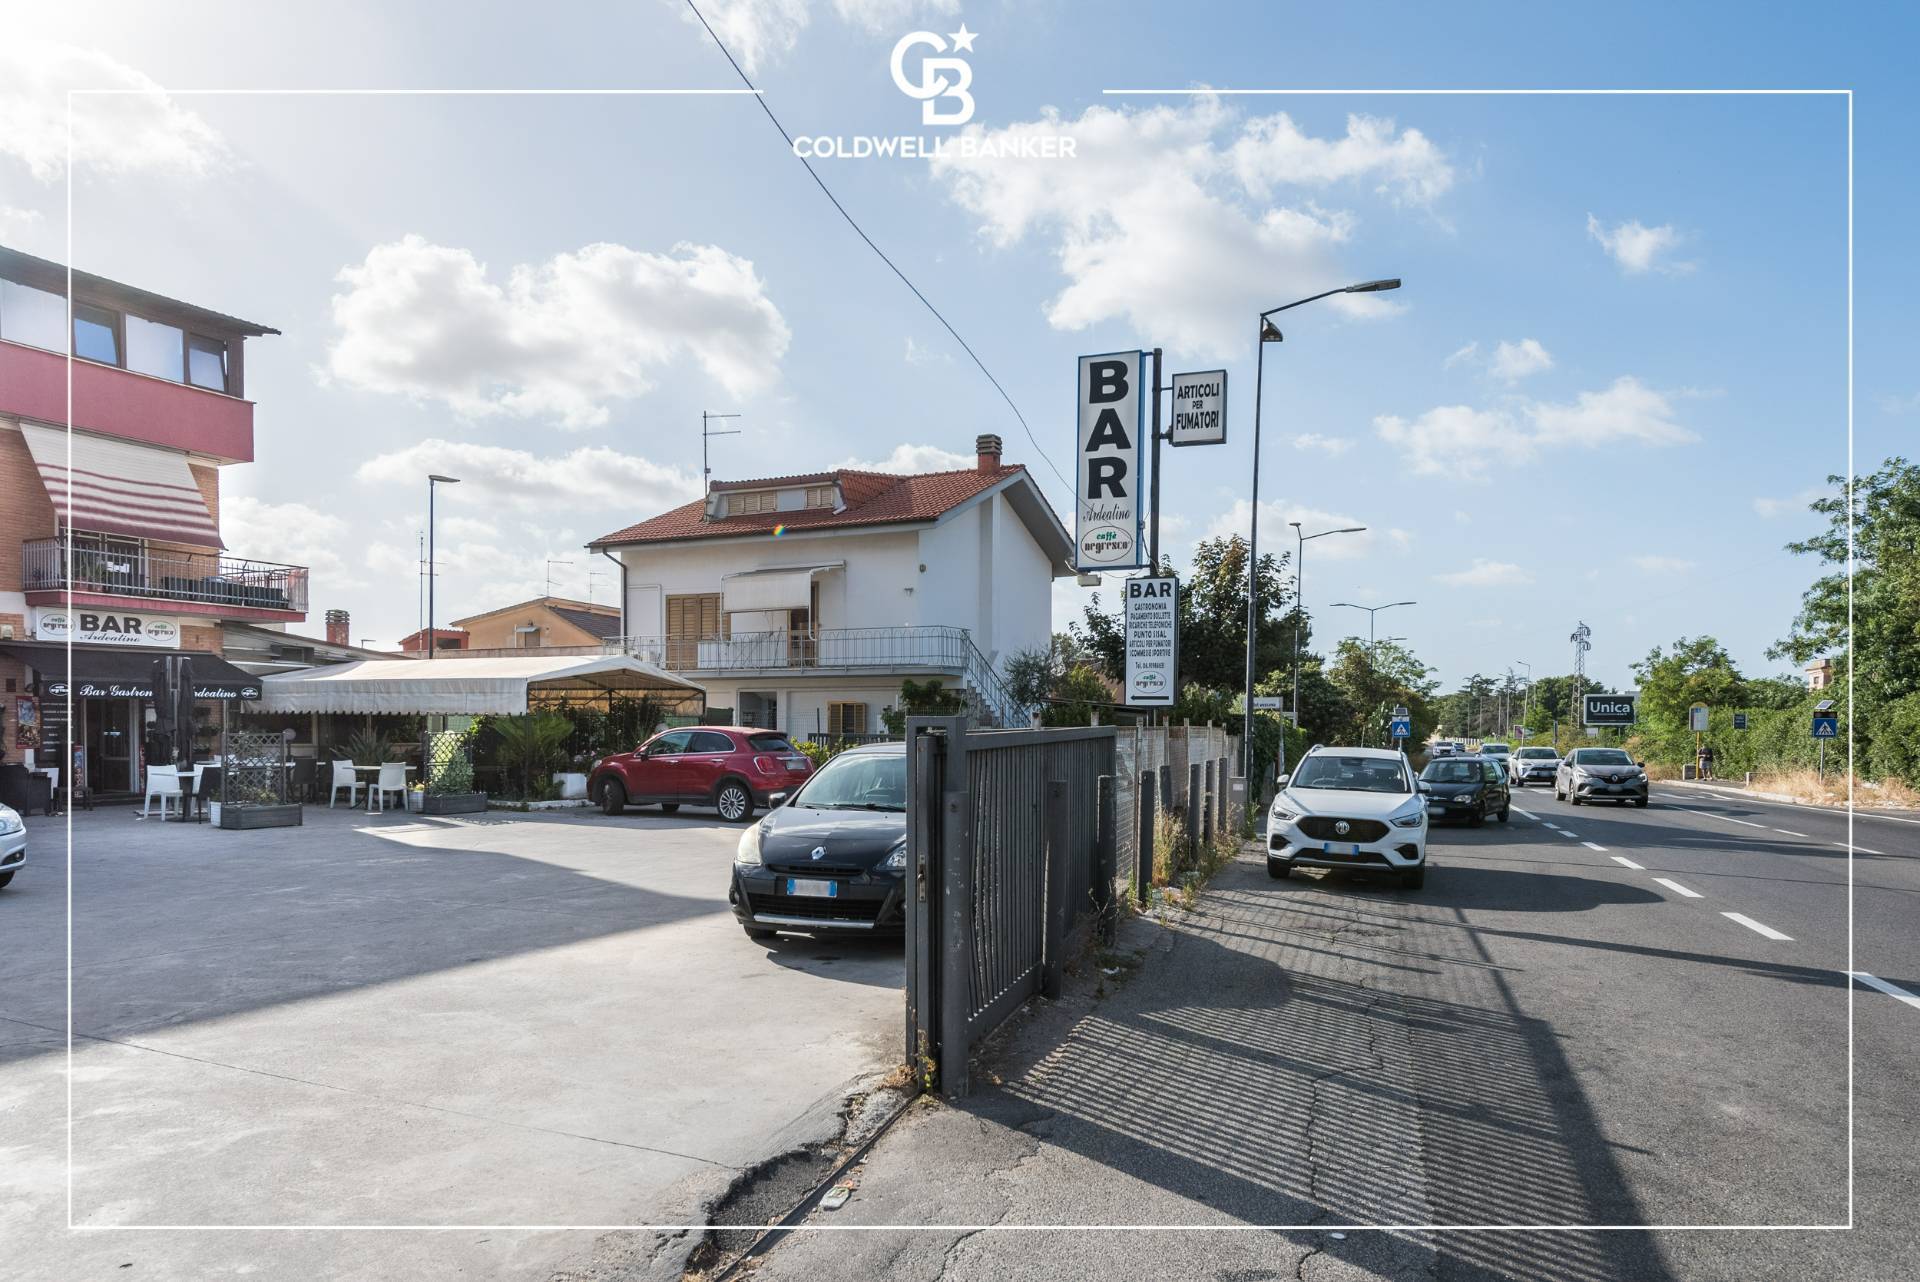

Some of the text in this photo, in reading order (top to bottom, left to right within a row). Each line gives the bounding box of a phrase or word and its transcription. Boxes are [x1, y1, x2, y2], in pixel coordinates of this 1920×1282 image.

[1177, 382, 1220, 399] ARTICOLI
[1192, 400, 1204, 409] PER
[1176, 410, 1219, 430] FUMATORI
[1085, 360, 1131, 499] BAR
[1130, 582, 1172, 598] BAR
[80, 614, 142, 634] BAR
[1134, 630, 1152, 639] PUNTO
[80, 684, 107, 696] Bar
[193, 686, 236, 698] rdeatino
[1590, 701, 1631, 713] Unica
